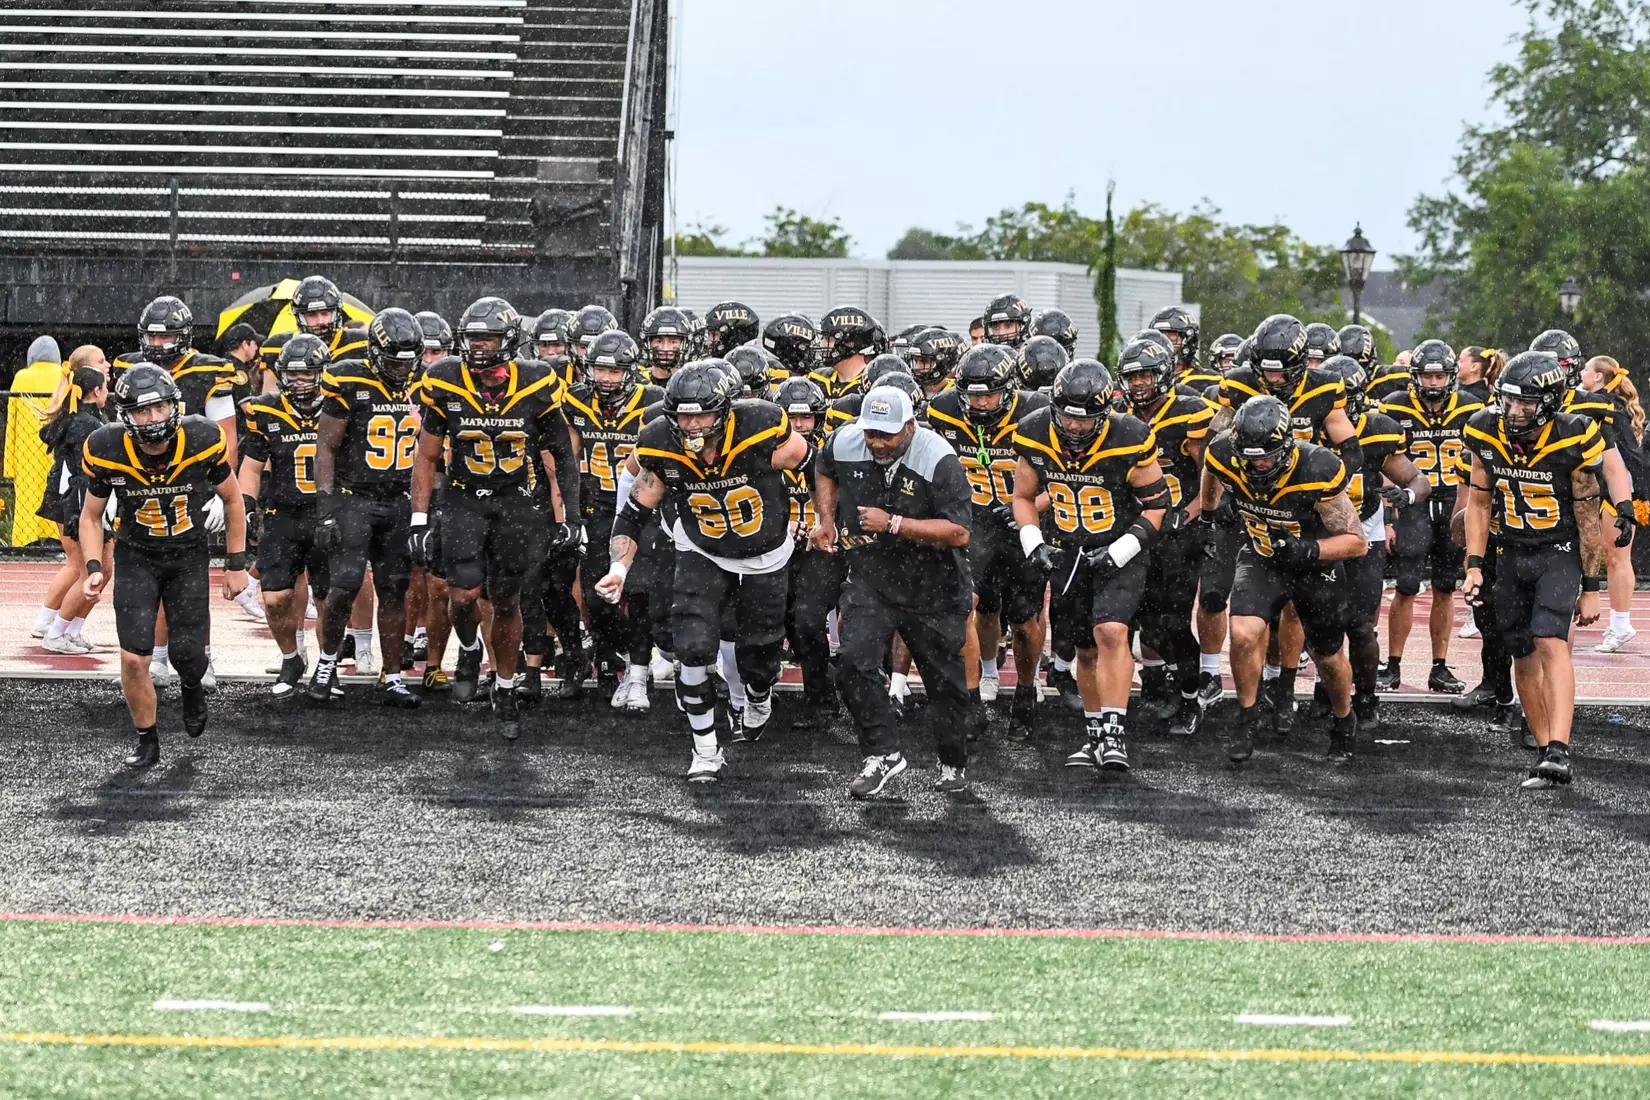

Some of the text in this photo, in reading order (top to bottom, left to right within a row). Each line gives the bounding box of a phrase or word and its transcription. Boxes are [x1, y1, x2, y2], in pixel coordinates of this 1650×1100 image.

[715, 309, 749, 321] VILLE
[830, 315, 865, 327] VILLE
[784, 322, 814, 341] VILLE
[871, 405, 889, 413] PSAC
[459, 416, 525, 428] MARAUDERS
[280, 433, 318, 443] MARAUD
[365, 414, 421, 470] 92
[581, 430, 639, 441] MARAUDERS
[456, 429, 529, 475] 33
[1409, 438, 1463, 487] 28
[684, 473, 749, 492] MARAUDERS
[1045, 470, 1105, 485] MARAUDERS
[1492, 465, 1553, 482] MARAUDERS
[126, 483, 194, 497] MARAUDERS
[687, 484, 764, 540] 60
[1047, 481, 1116, 534] 88
[1235, 497, 1293, 519] MARAUDERS
[1495, 478, 1561, 530] 15
[134, 494, 194, 537] 41
